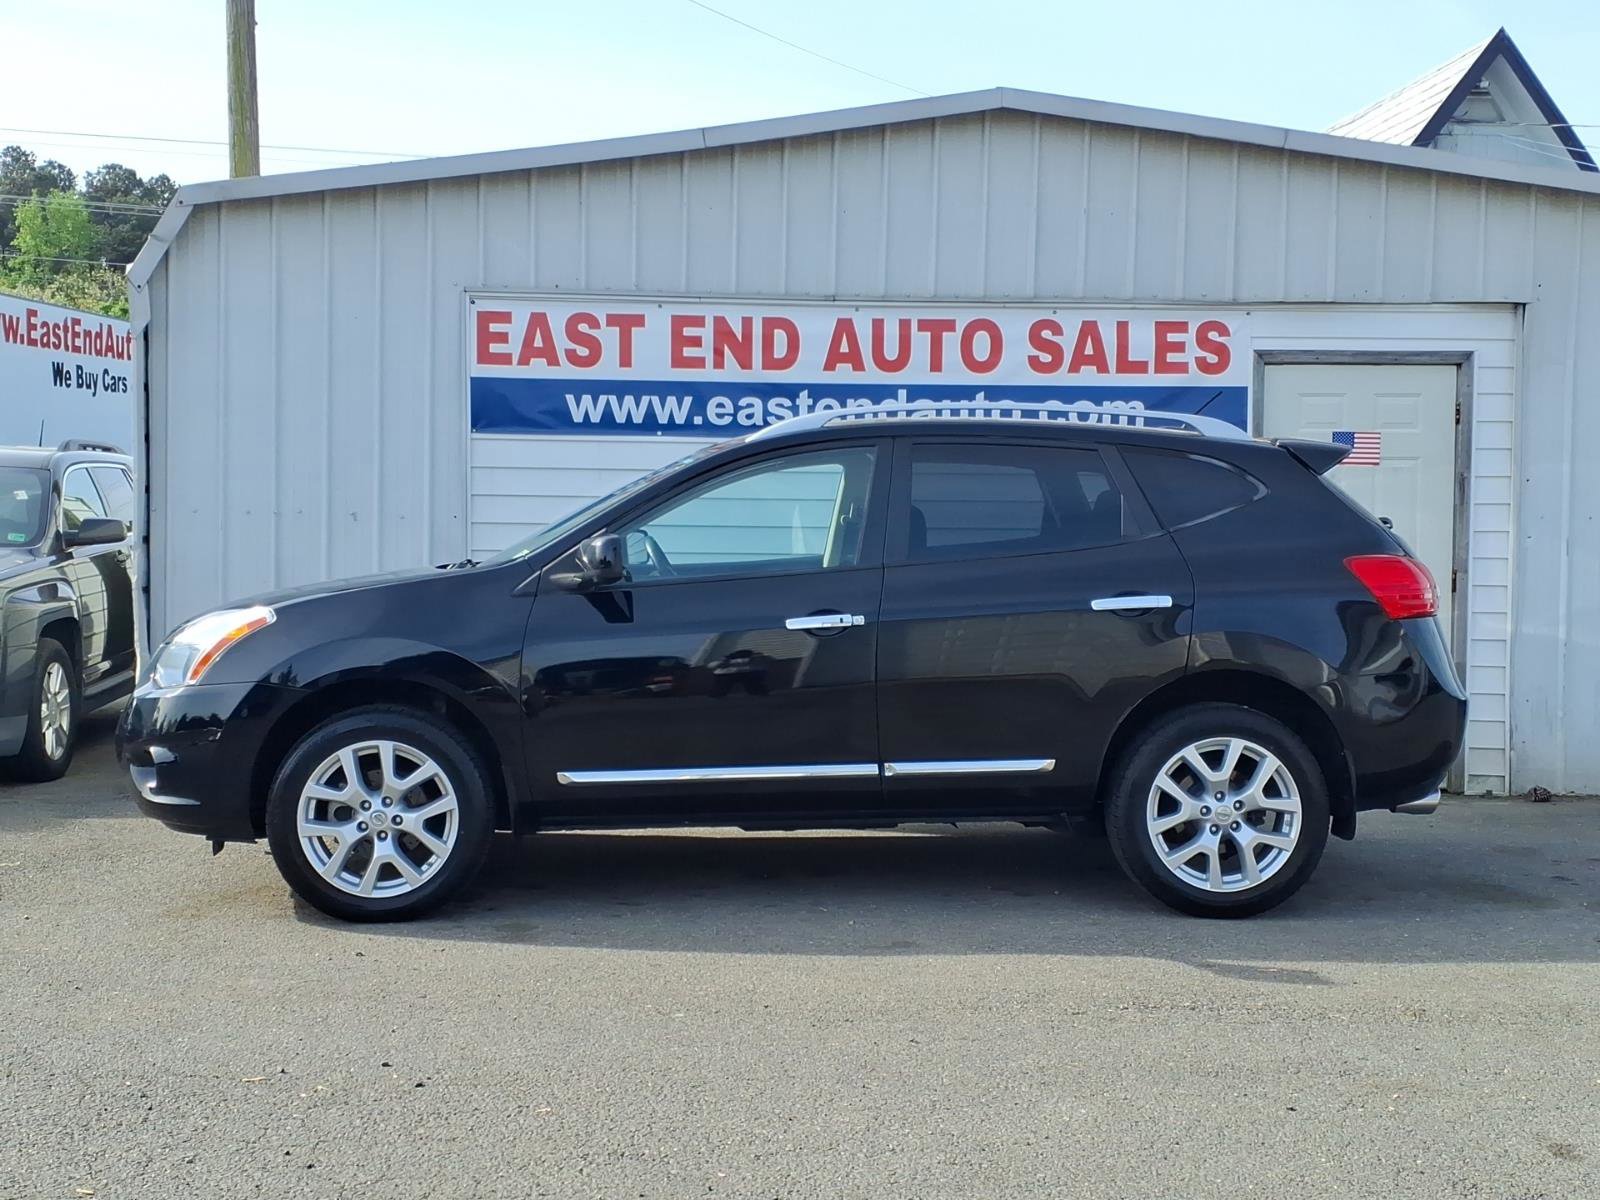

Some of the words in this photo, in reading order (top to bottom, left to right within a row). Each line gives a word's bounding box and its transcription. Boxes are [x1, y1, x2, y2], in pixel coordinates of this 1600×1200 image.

[0, 307, 131, 360] w.EastEndAut
[476, 311, 646, 369] EAST
[670, 314, 801, 372] END
[822, 317, 1004, 375] AUTO
[1027, 318, 1231, 376] SALES
[52, 361, 72, 388] We
[76, 364, 99, 397] Buy
[102, 368, 128, 394] Cars
[565, 389, 1145, 428] www.eastndtom
